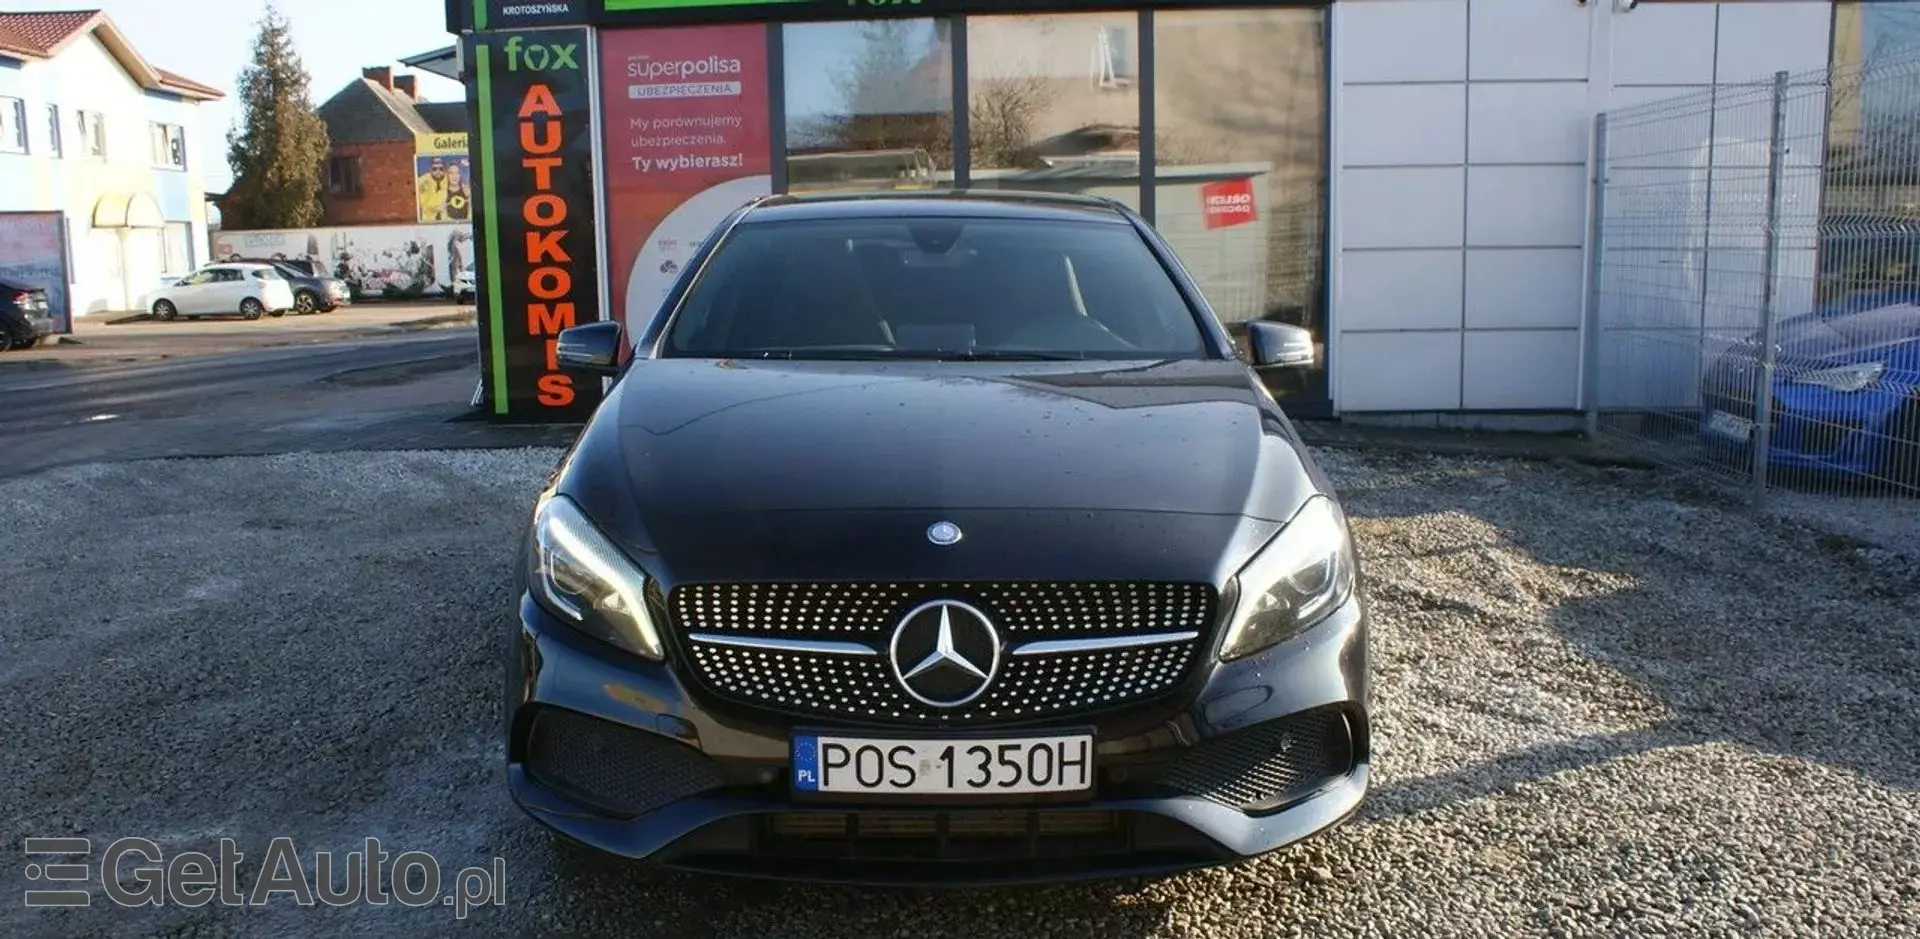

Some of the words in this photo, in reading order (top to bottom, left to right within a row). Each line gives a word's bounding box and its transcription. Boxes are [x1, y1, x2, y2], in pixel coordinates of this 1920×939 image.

[502, 3, 569, 16] KROTOSZYŃSKA
[504, 35, 579, 71] fox
[628, 55, 741, 81] superpolisa
[637, 84, 733, 97] UBEZPIECZENIA
[629, 118, 650, 131] My
[652, 114, 743, 130] porównujemy
[433, 136, 467, 149] Galeri
[631, 132, 726, 148] ubezpieczenia.
[632, 156, 651, 173] Ty
[655, 153, 744, 171] wybierasz!
[517, 84, 576, 407] AUTOKOMIS
[821, 742, 917, 789] POS
[939, 740, 1087, 789] 1350H
[797, 769, 816, 784] PL
